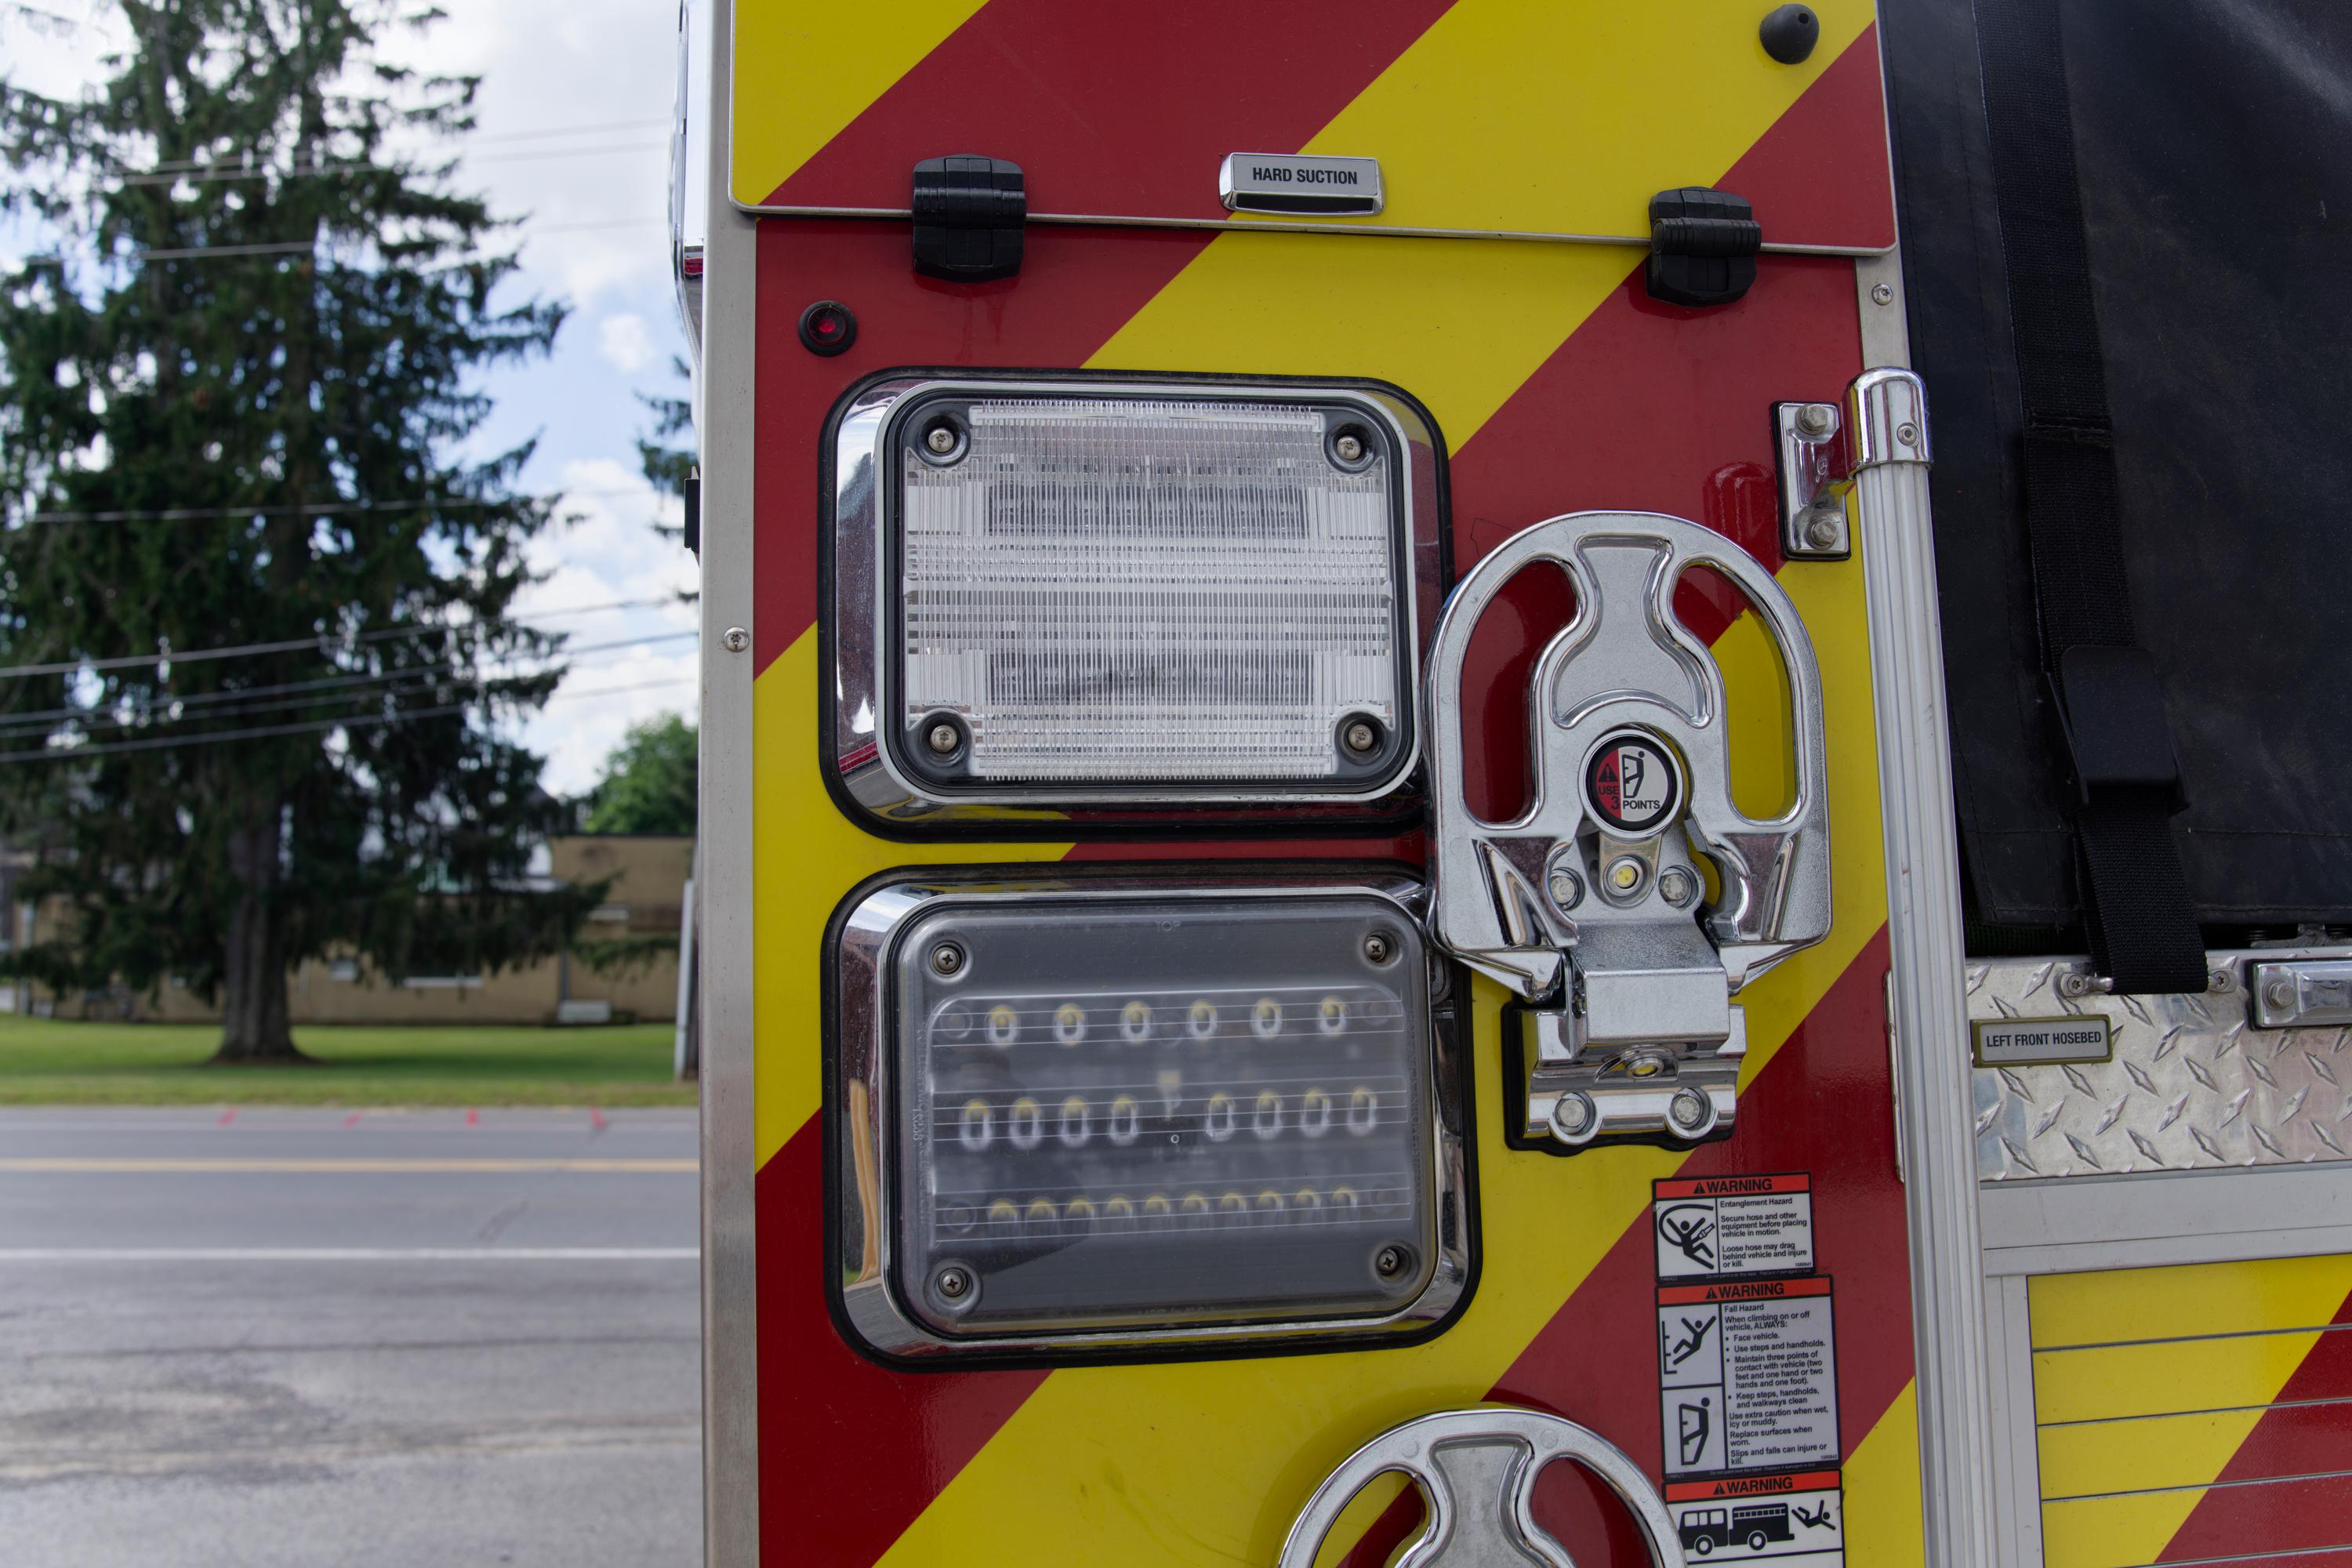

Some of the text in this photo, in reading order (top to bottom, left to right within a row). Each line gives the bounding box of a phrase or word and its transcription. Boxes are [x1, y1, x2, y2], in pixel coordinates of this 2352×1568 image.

[1253, 167, 1357, 185] HARD SUCTION
[1599, 785, 1620, 795] USE
[1611, 796, 1661, 810] 3 POINTS
[1987, 1031, 2101, 1047] LEFT FRONT HOSEBED
[1706, 1178, 1772, 1193] WARNING
[1720, 1199, 1767, 1208] Entanglement
[1721, 1222, 1757, 1231] equipment
[1783, 1219, 1807, 1228] placing
[1788, 1249, 1807, 1258] injure
[1719, 1282, 1784, 1298] WARNING
[1739, 1303, 1764, 1312] Hazard
[1748, 1313, 1778, 1322] climbing
[1754, 1320, 1788, 1330] ALWAYS:
[1750, 1344, 1769, 1352] steps
[1787, 1340, 1825, 1348] handholds.
[1734, 1355, 1766, 1363] Maintain
[1781, 1368, 1799, 1377] hand
[1756, 1391, 1778, 1399] steps,
[1780, 1387, 1819, 1396] handholds,
[1752, 1399, 1787, 1408] walkways
[1765, 1409, 1791, 1417] caution
[1751, 1417, 1777, 1426] muddy.
[1730, 1431, 1759, 1439] Replace
[1751, 1447, 1764, 1456] and
[1766, 1446, 1780, 1454] falls
[1797, 1443, 1817, 1453] injure
[1726, 1477, 1793, 1494] WARNING
